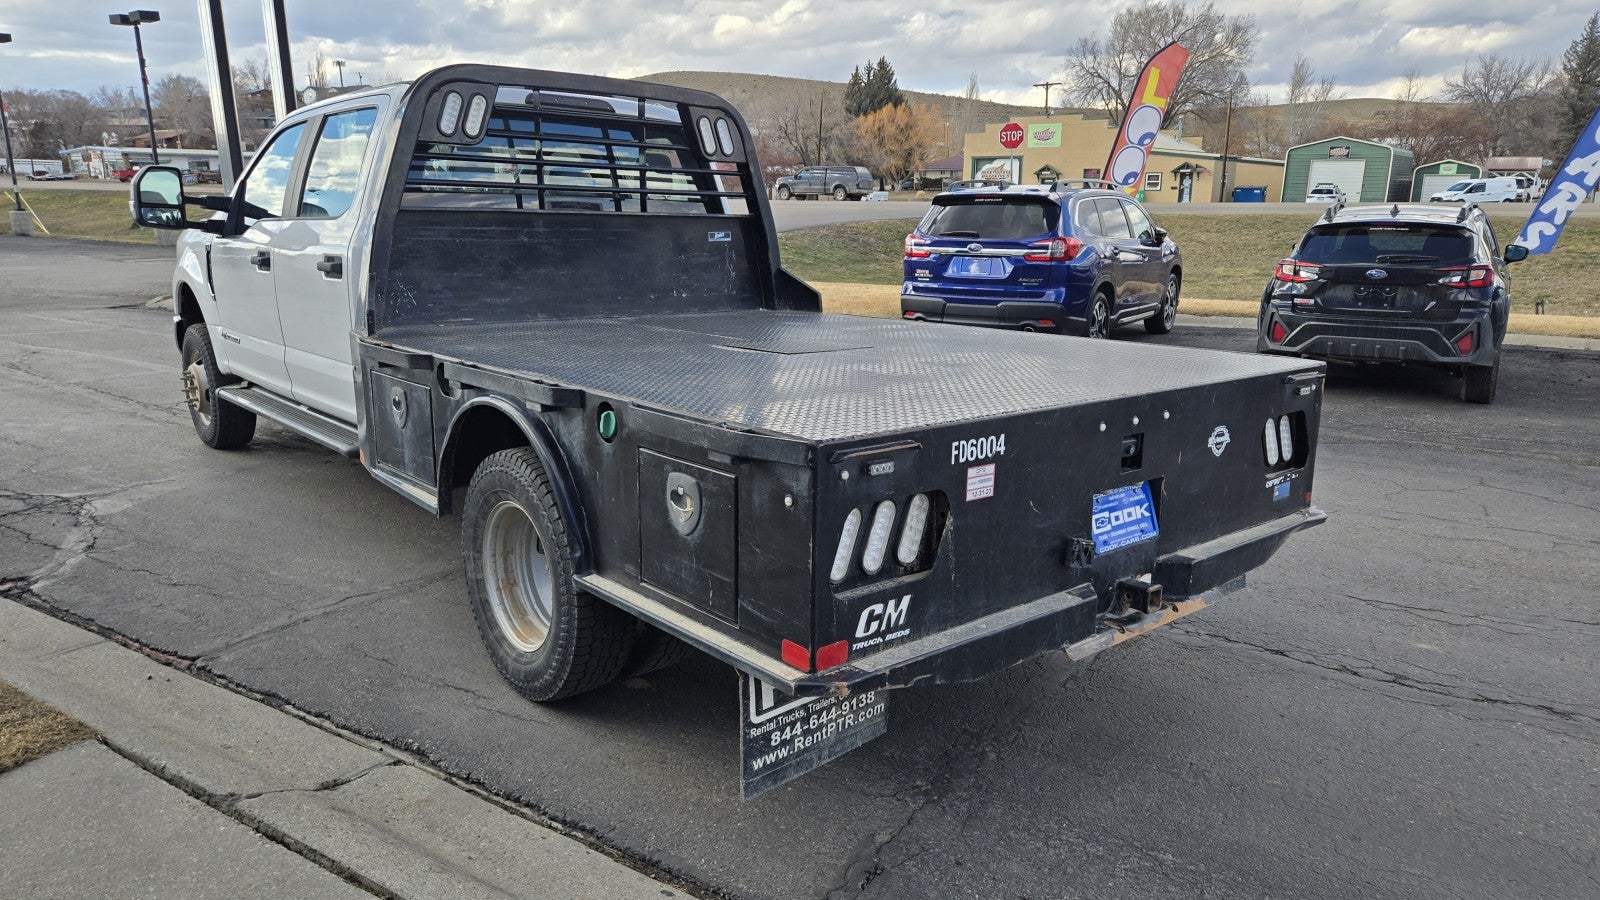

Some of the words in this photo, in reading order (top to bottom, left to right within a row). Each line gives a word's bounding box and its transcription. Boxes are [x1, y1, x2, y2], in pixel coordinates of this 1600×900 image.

[1000, 130, 1023, 142] STOP
[951, 433, 1006, 465] FD6004
[1092, 503, 1152, 535] COOK
[1100, 531, 1157, 553] COOK-CARS.COM
[855, 594, 911, 638] CM
[852, 637, 883, 651] TRUCK
[885, 628, 911, 641] BEDS
[750, 719, 776, 738] Rental
[778, 709, 807, 726] Trucks,
[770, 691, 875, 746] 844-644-9138
[752, 702, 885, 771] www.RentPTR.com
